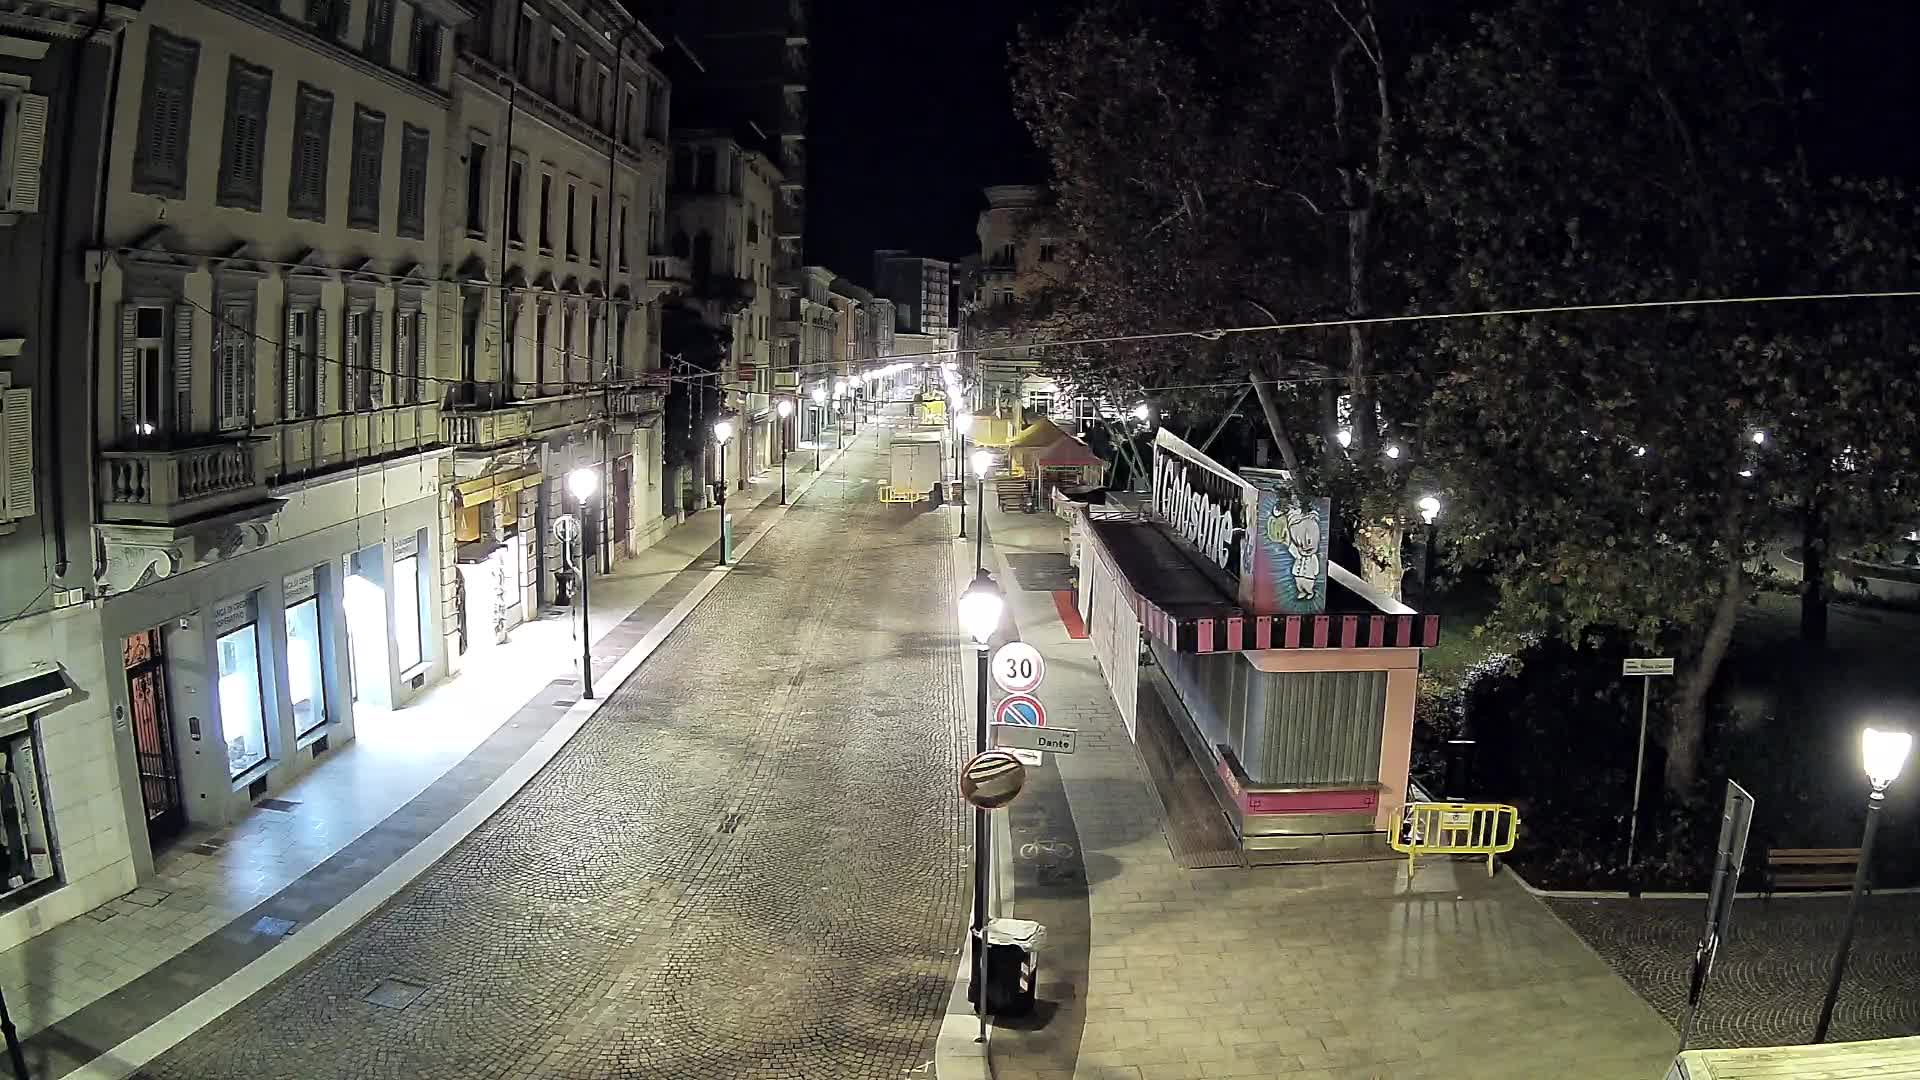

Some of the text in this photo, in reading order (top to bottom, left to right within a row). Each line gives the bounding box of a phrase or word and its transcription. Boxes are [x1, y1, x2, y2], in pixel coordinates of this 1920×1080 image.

[1162, 458, 1233, 569] Golosone
[1006, 658, 1032, 679] 30
[1038, 737, 1070, 749] Dante
